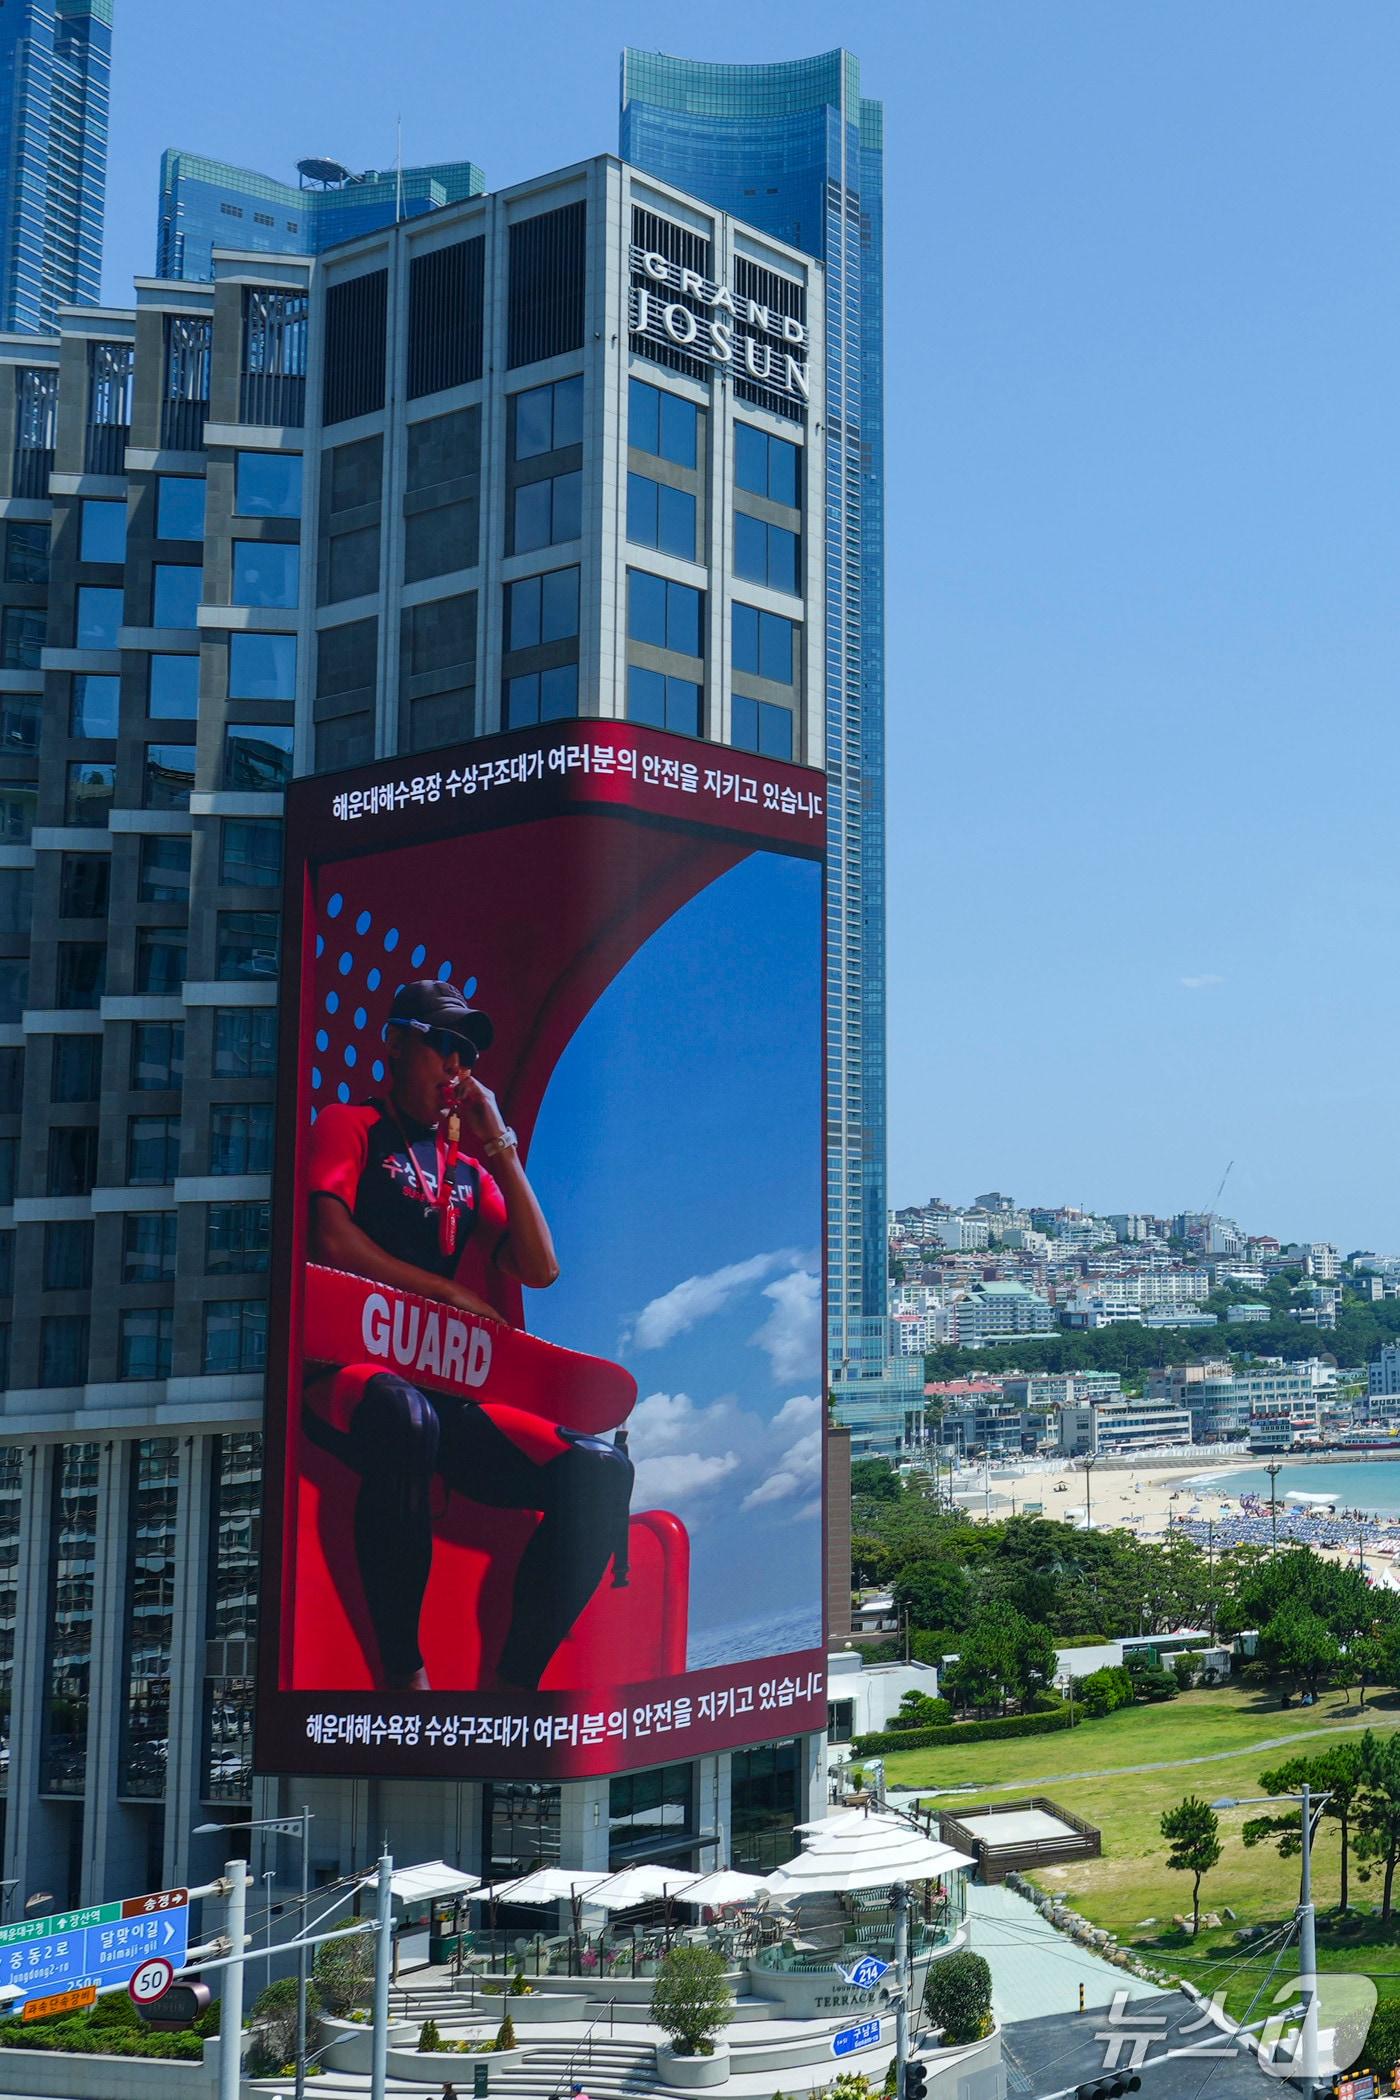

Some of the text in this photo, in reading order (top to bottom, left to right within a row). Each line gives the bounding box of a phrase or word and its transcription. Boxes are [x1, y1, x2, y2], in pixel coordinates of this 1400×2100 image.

[642, 252, 804, 343] GRAND
[629, 287, 811, 400] JOSUN
[333, 772, 442, 821] 해운대해수욕장
[445, 750, 544, 798] 수상구조대가
[549, 744, 637, 779] 여러분의
[642, 755, 699, 794] 안전을
[704, 769, 758, 804] 지키고
[361, 1293, 492, 1388] GUARD
[306, 1714, 421, 1746] 해운대해수욕장
[424, 1715, 529, 1747] 수상구조대가
[533, 1708, 627, 1748] 여러분의
[633, 1697, 693, 1737] 안전을
[697, 1686, 754, 1722] 지키고
[143, 1894, 169, 1911] 송정
[69, 1909, 100, 1928] 장산역
[101, 1920, 158, 1949] 달맞이길
[9, 1941, 69, 1970] 중동2로
[100, 1940, 157, 1963] Dalmaji-gil
[140, 1970, 162, 1992] 50
[859, 1965, 878, 1983] 214
[28, 1990, 89, 2014] 과속단속장비
[814, 1992, 875, 2008] TERRACE
[853, 2022, 878, 2039] 구남로
